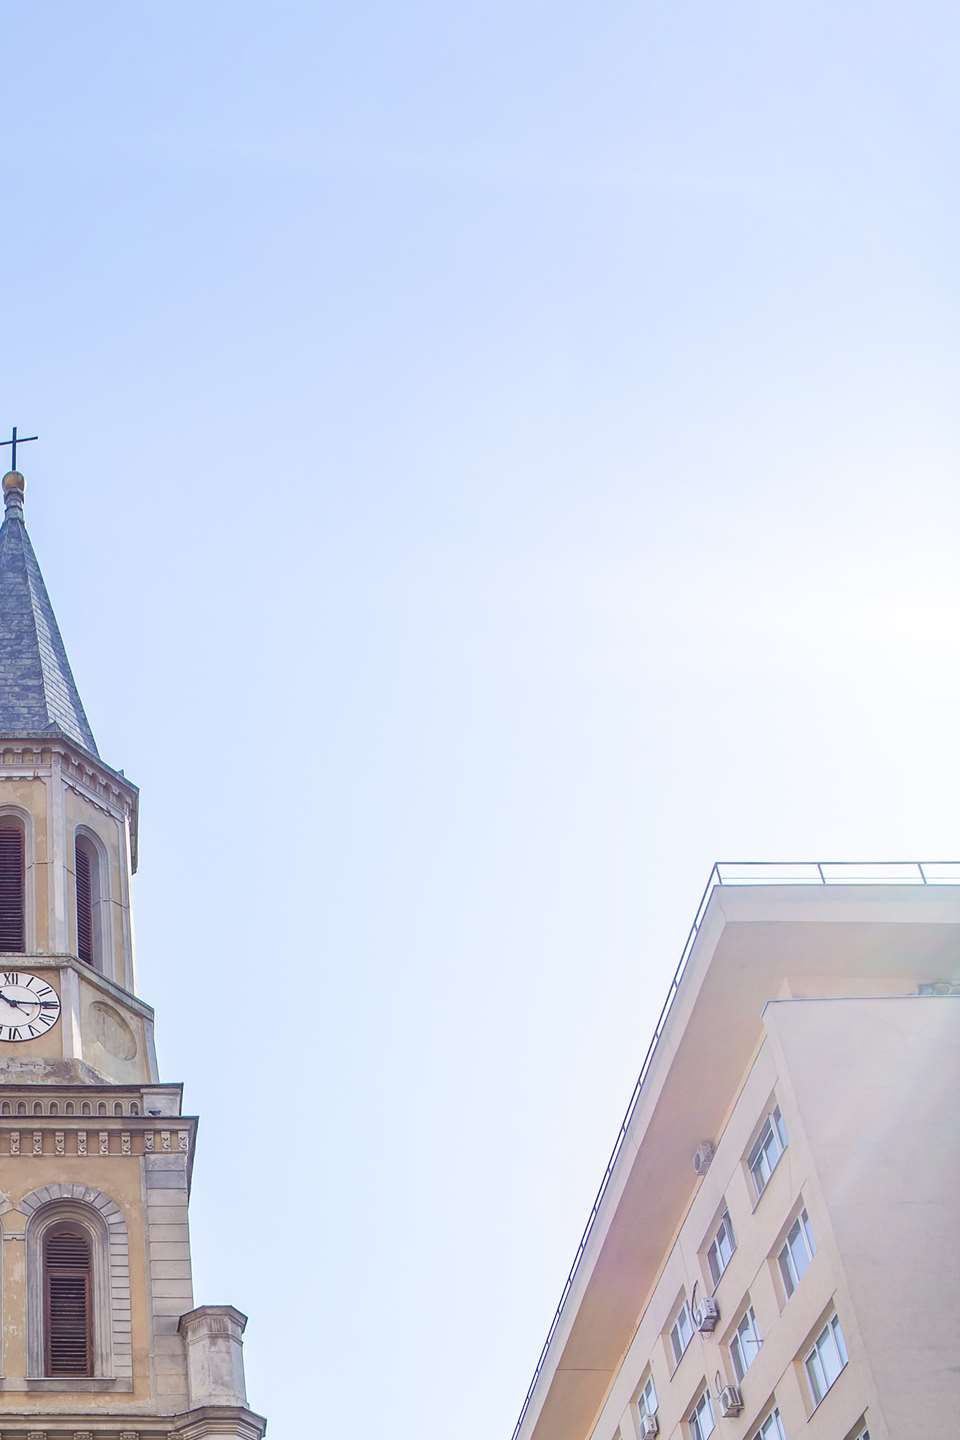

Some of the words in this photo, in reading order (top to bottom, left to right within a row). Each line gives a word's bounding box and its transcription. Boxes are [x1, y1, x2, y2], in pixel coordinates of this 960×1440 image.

[4, 973, 18, 986] XII
[36, 986, 53, 997] II
[41, 1001, 58, 1009] II
[9, 1027, 23, 1040] VI
[28, 1025, 41, 1036] V
